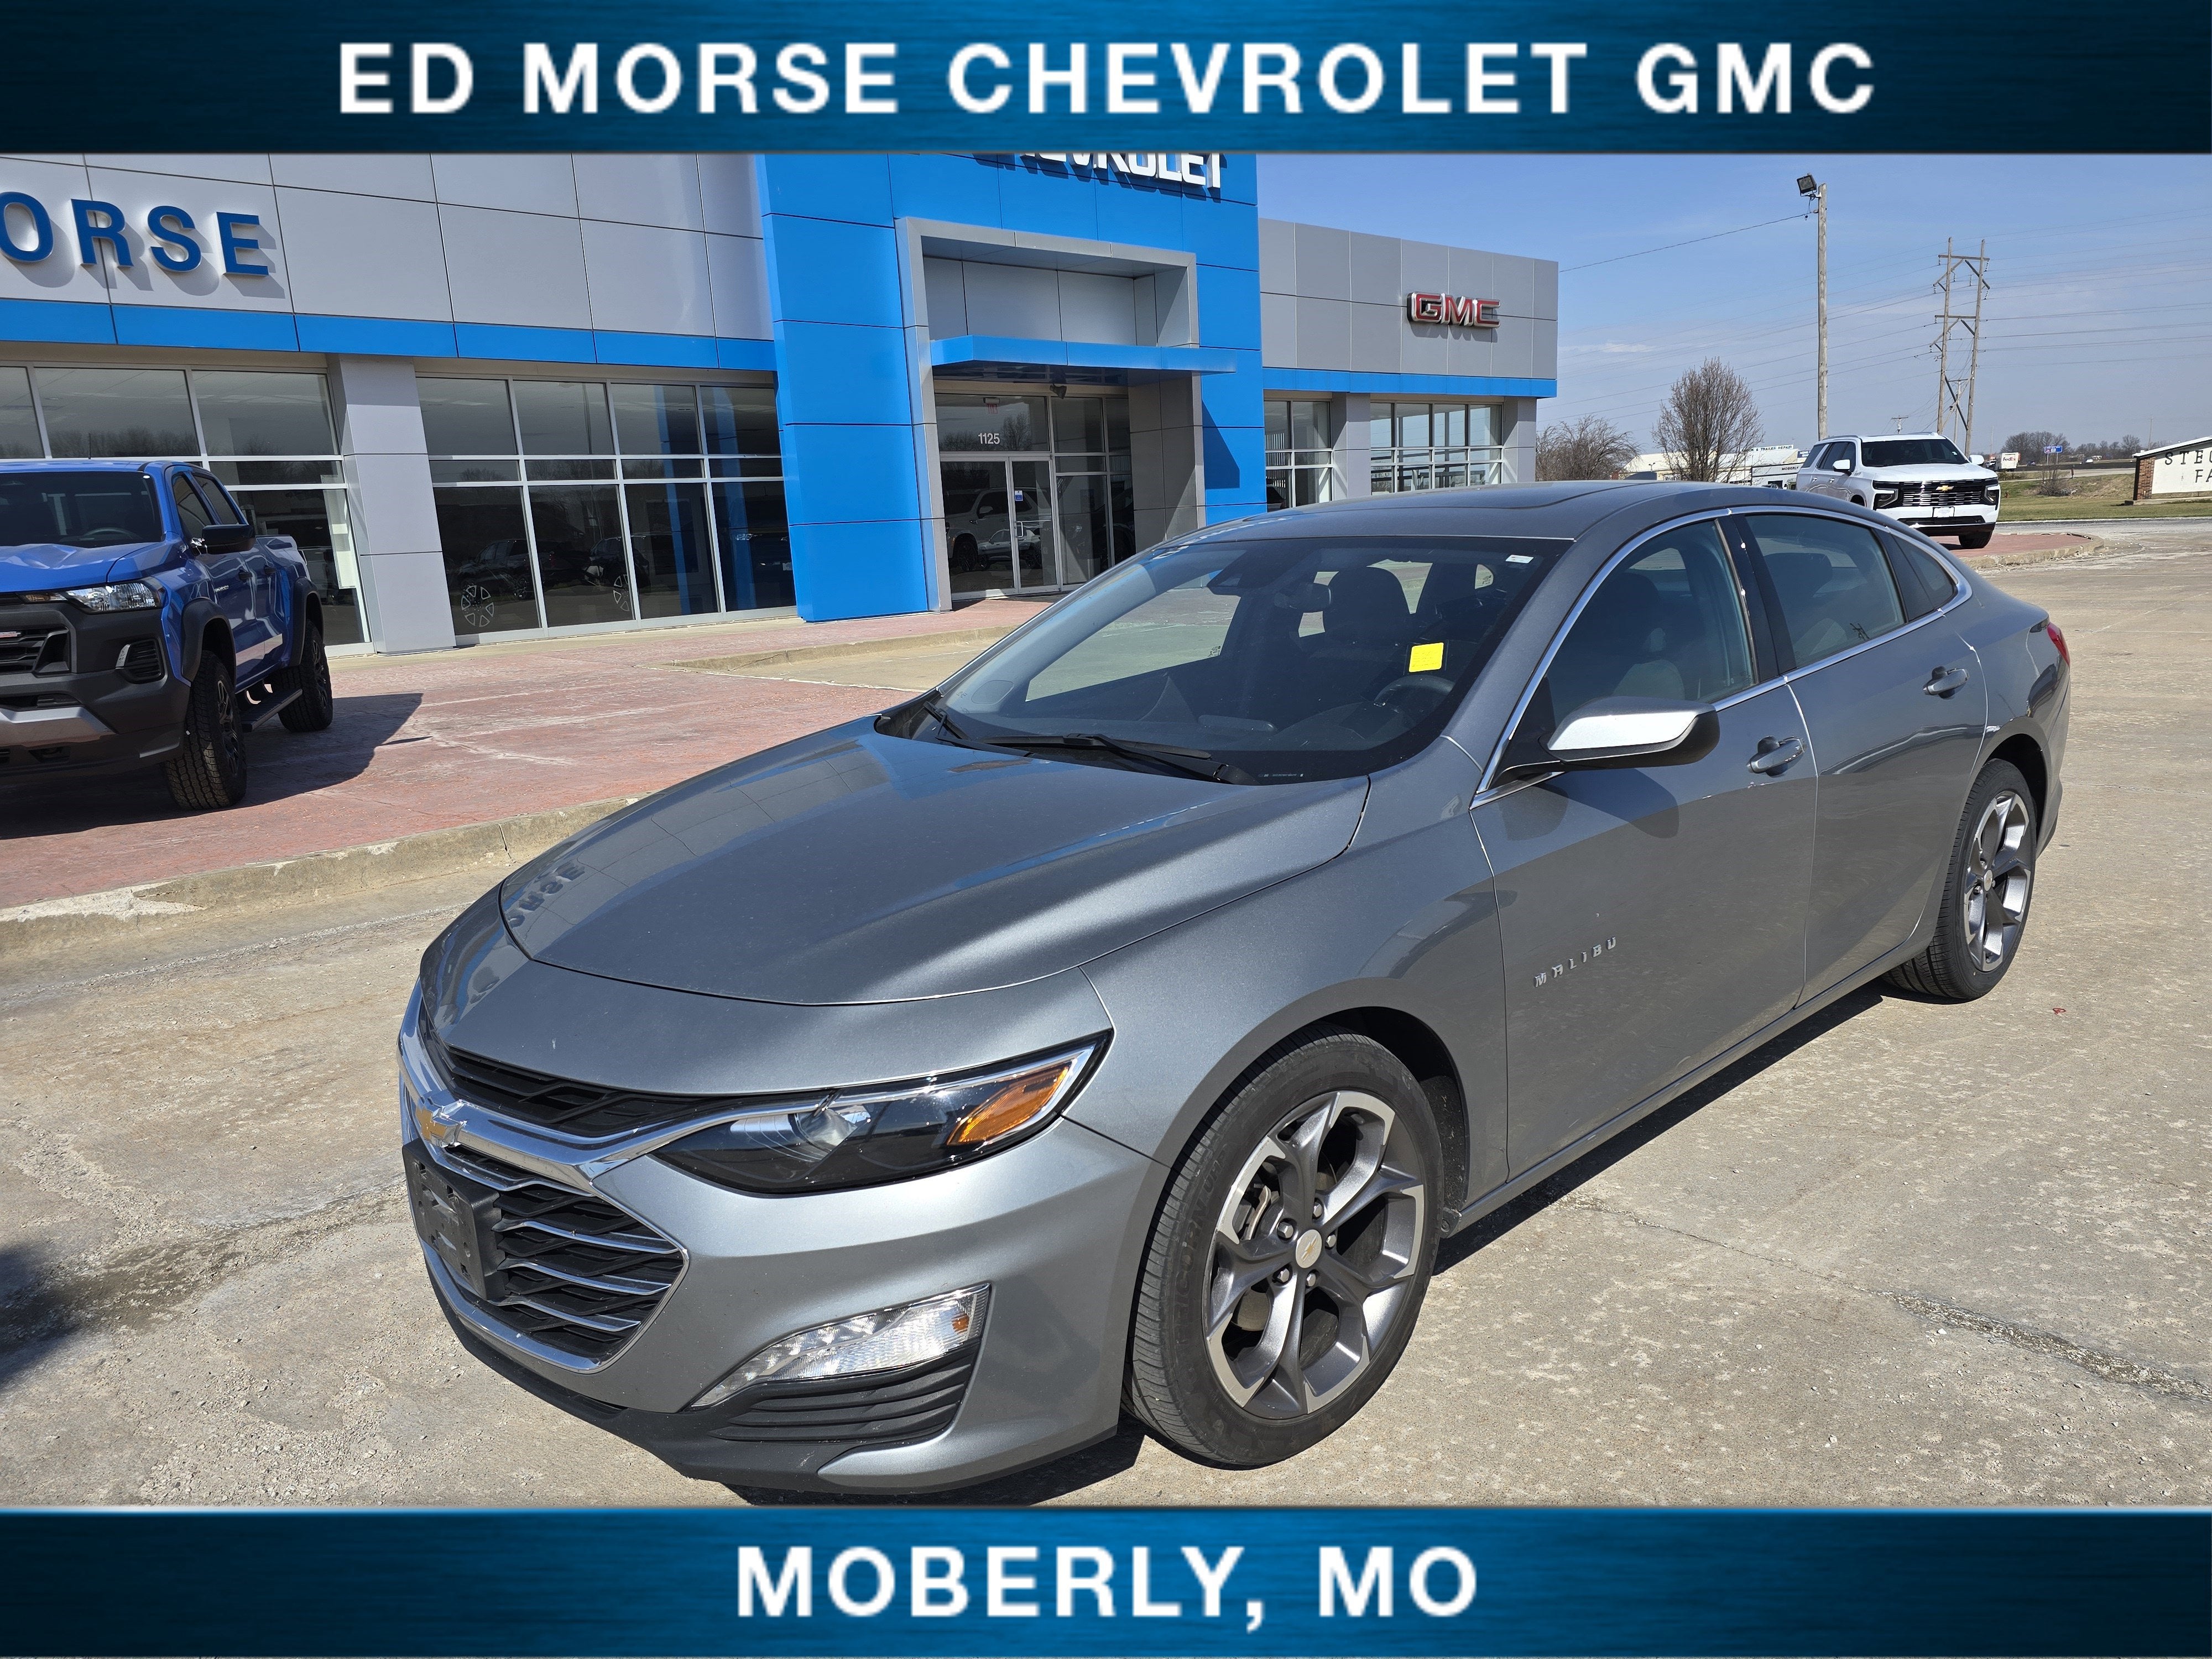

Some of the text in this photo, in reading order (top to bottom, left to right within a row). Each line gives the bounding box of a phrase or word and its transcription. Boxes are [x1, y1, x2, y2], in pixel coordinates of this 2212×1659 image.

[1407, 291, 1500, 328] GMC
[978, 432, 1000, 445] 1125
[1534, 937, 1616, 988] MALIBU
